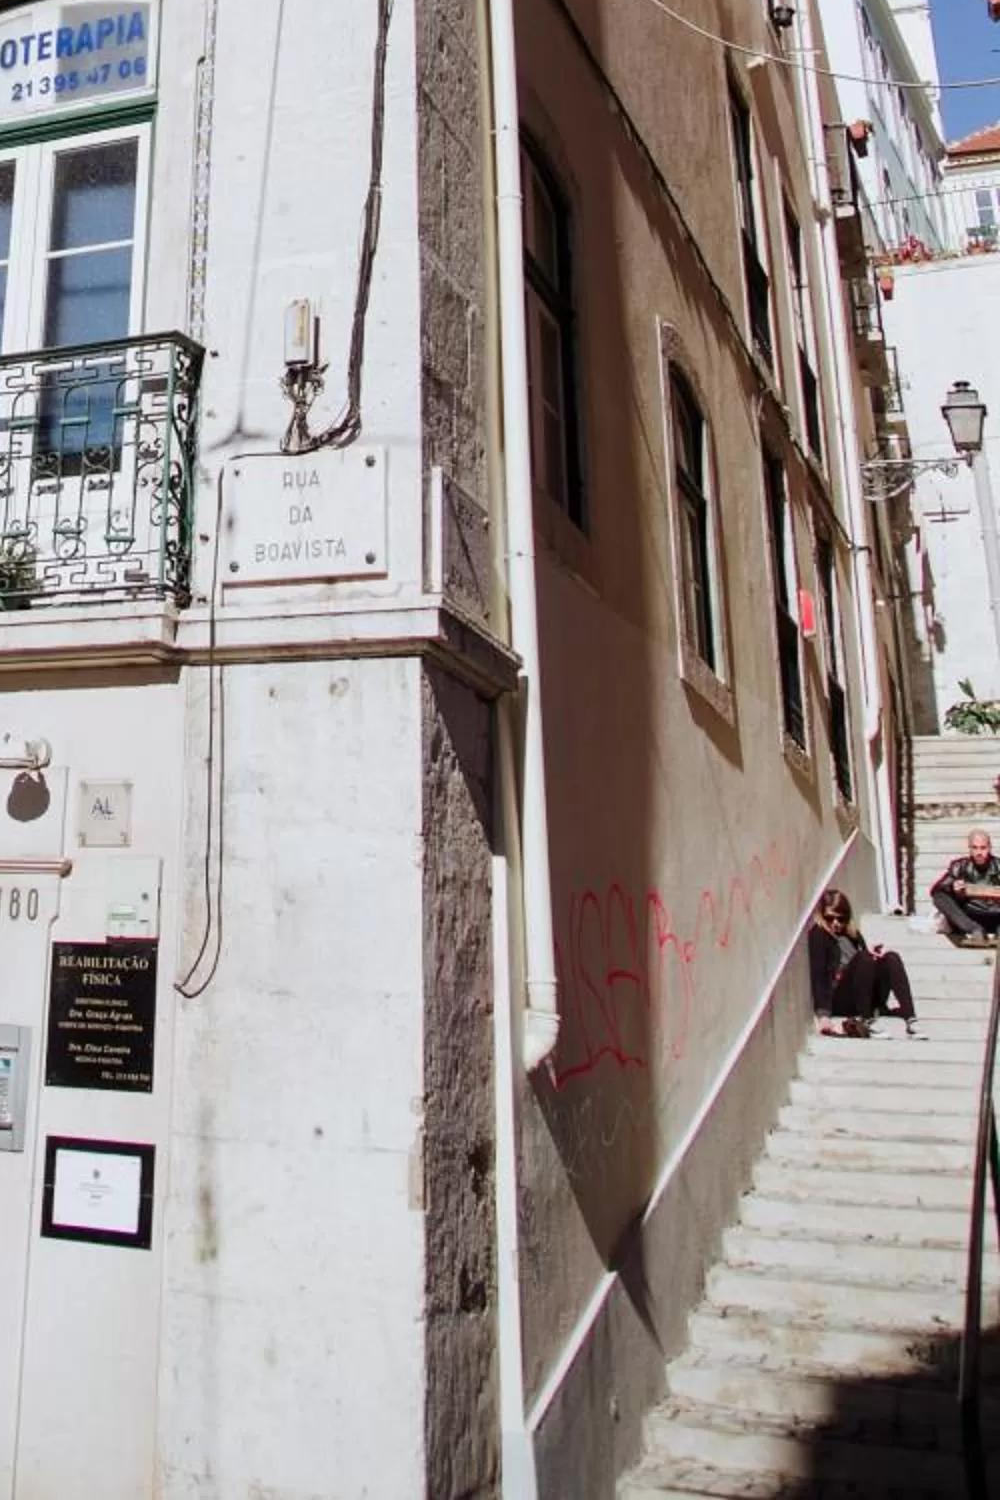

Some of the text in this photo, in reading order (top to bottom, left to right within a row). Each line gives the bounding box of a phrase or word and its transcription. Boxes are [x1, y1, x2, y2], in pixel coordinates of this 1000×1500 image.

[11, 80, 33, 102] 21
[118, 56, 147, 79] 06
[282, 469, 321, 489] RUA
[289, 505, 313, 525] DA
[254, 538, 347, 563] BOAVISTA
[91, 796, 114, 816] AL
[58, 955, 149, 972] REABILITAÇÃO
